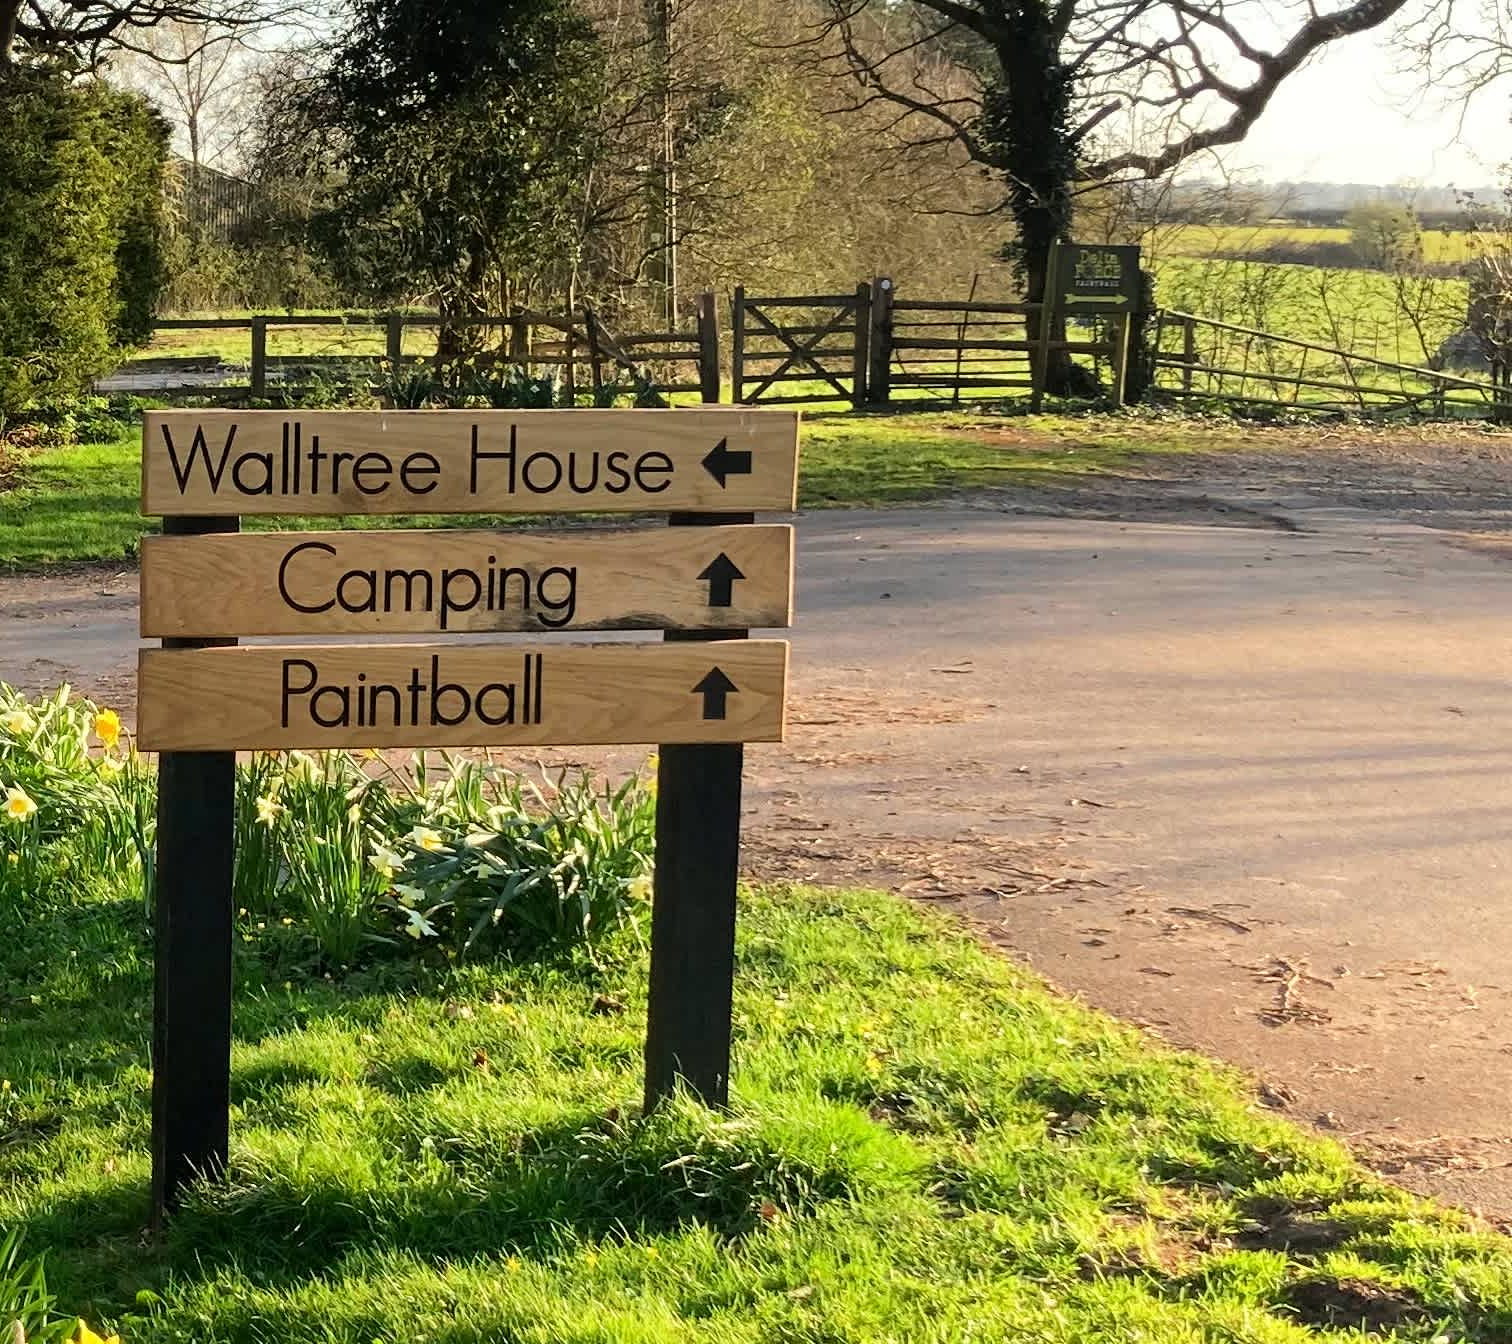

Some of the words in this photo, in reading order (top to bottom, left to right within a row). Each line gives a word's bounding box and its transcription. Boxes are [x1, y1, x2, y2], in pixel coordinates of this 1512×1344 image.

[160, 421, 442, 497] Walltree
[469, 423, 676, 496] House
[277, 540, 578, 629] Camping
[280, 652, 544, 730] Paintball
